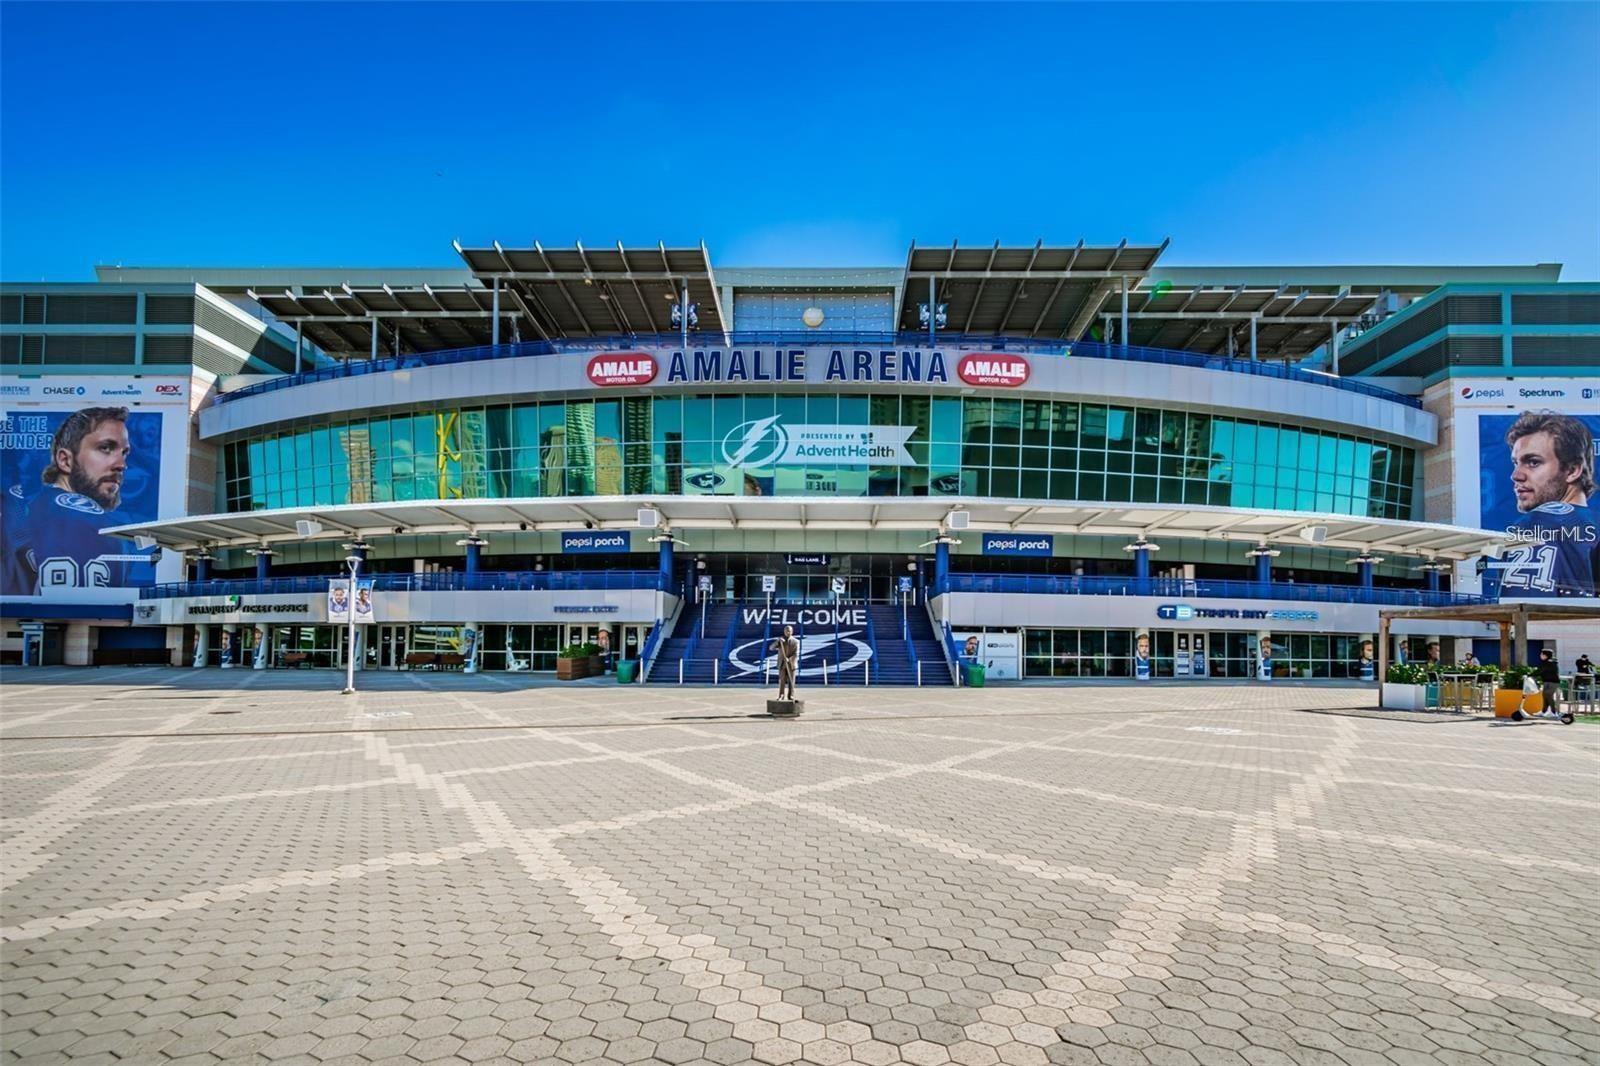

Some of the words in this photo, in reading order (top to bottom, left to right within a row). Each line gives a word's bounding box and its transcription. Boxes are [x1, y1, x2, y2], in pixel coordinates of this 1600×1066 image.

[592, 361, 652, 378] AMALIE
[667, 350, 806, 383] AMALIE
[825, 350, 949, 383] ARENA
[964, 361, 1025, 379] AMALIE
[43, 386, 75, 395] CHASE
[155, 385, 180, 393] DEX
[1475, 388, 1504, 399] pepsi
[1519, 388, 1561, 398] Spectrum
[18, 416, 48, 432] THE
[796, 444, 895, 458] AdventHealth
[565, 536, 592, 548] pepsi
[595, 536, 625, 548] porch
[987, 539, 1017, 550] pepsi
[1019, 539, 1050, 551] porch
[743, 609, 868, 625] WELCOME
[1196, 608, 1239, 619] TAMPA
[1242, 610, 1268, 620] BAY
